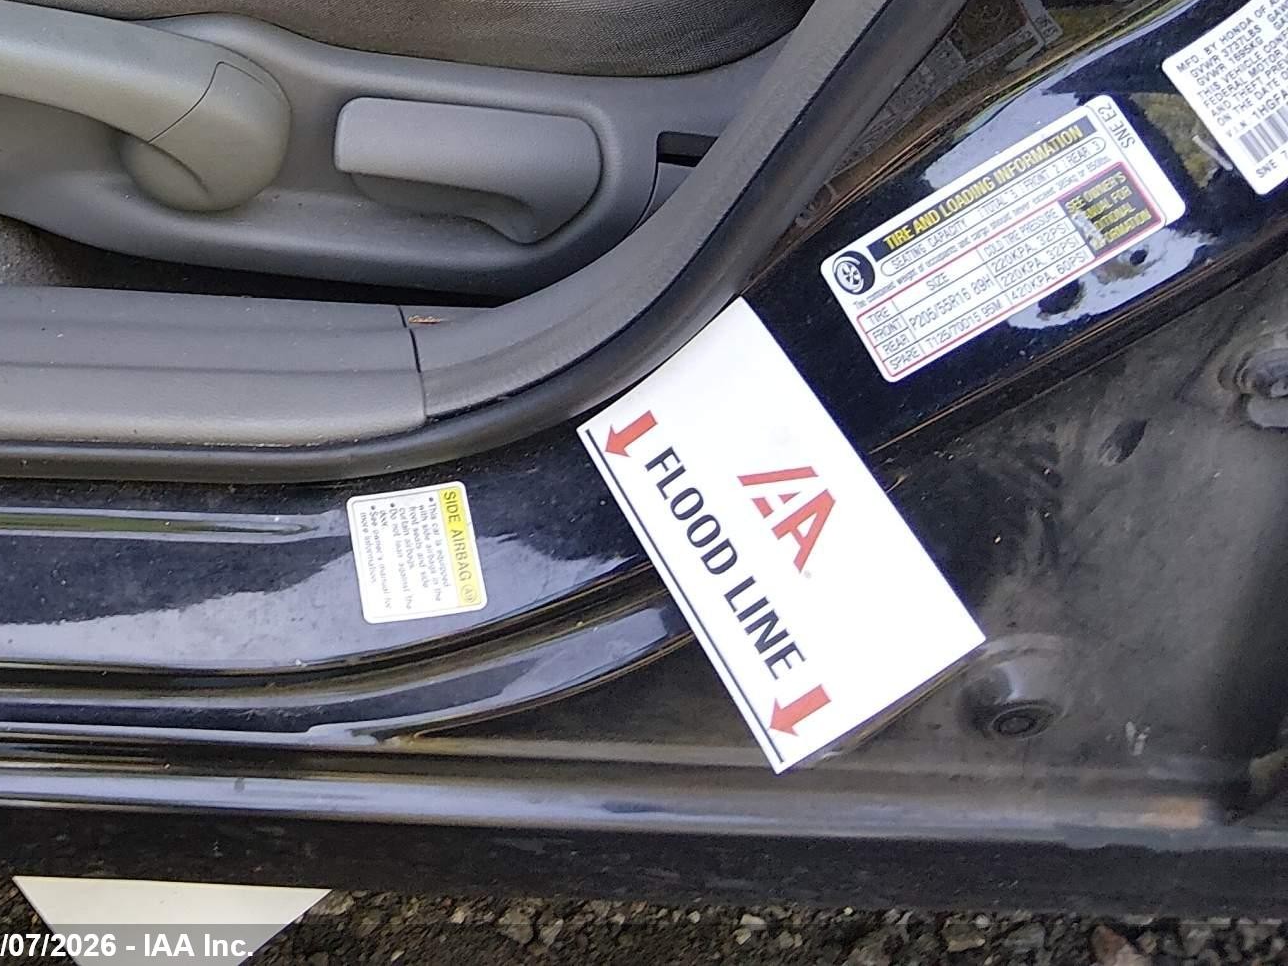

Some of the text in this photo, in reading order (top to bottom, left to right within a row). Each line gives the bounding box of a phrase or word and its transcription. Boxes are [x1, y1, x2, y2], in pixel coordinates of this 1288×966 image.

[1190, 54, 1220, 78] GVWR
[1221, 24, 1262, 57] 3737LBS
[1203, 42, 1217, 55] BY
[1219, 17, 1253, 42] HONDA
[1254, 4, 1266, 18] OF
[1196, 63, 1226, 86] GVWR
[1197, 81, 1221, 96] THIS
[1222, 51, 1262, 83] VEHICLE
[1203, 78, 1248, 107] FEDERAL
[1248, 49, 1283, 78] MOTOR
[1211, 99, 1232, 117] AND
[1232, 76, 1262, 99] THEFT
[1097, 103, 1135, 148] SNE E2
[1216, 114, 1232, 126] ON
[1232, 97, 1253, 112] THE
[1253, 78, 1280, 100] DATE
[883, 125, 1082, 249] TIRE AND LOADING INFORMATION
[1064, 171, 1126, 213] SEE OWNER'S
[1110, 185, 1132, 203] FOR
[1256, 159, 1277, 178] SNE
[891, 244, 926, 269] SEATING
[927, 218, 967, 247] CAPACITY
[981, 198, 1008, 214] TOTAL
[1023, 170, 1046, 188] FRONT
[1051, 164, 1061, 174] 2
[1066, 147, 1088, 164] REAR
[1091, 140, 1101, 150] 3
[867, 208, 1058, 324] TIRE SIZE COLD TIRE PRESSURE
[872, 317, 901, 339] FRONT
[1036, 222, 1070, 246] 32PSI
[882, 334, 910, 354] REAR
[1046, 236, 1079, 260] 32PSI
[889, 347, 920, 370] SPARE
[926, 312, 981, 347] T125/70D15
[1056, 250, 1089, 275] 60PSI
[909, 274, 994, 329] P205/55R16 89H
[388, 508, 398, 520] Do
[443, 491, 471, 581] SIDE AIRBAG
[644, 446, 807, 680] FLOOD LINE
